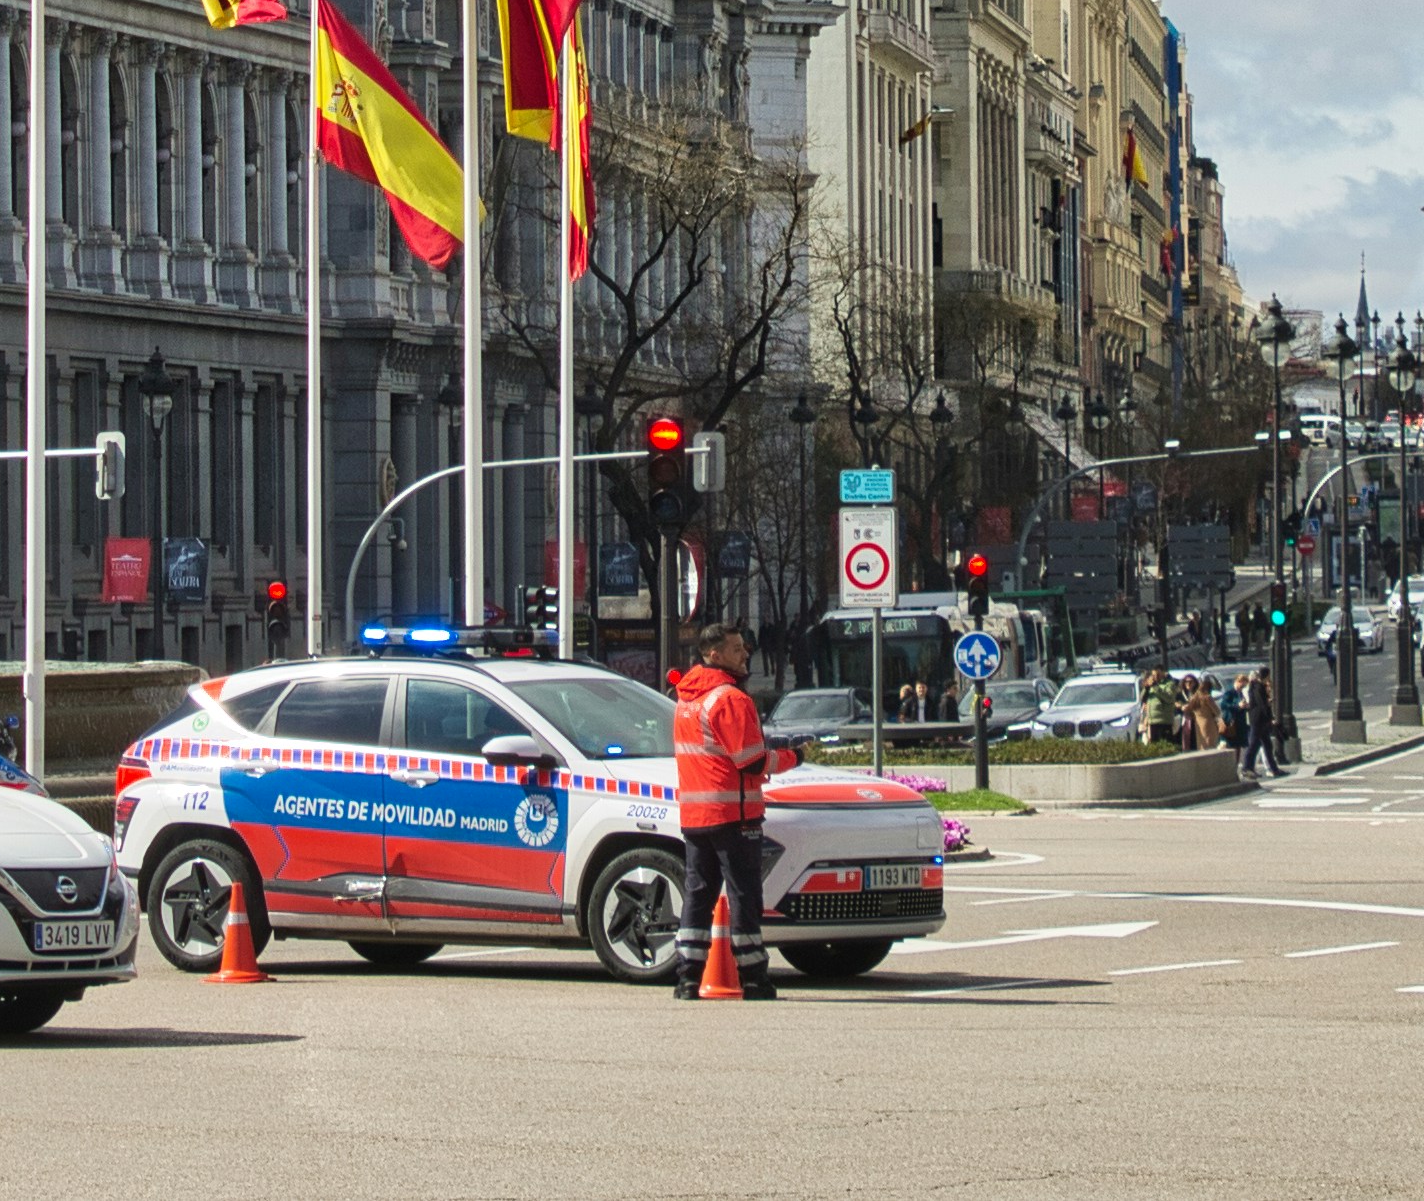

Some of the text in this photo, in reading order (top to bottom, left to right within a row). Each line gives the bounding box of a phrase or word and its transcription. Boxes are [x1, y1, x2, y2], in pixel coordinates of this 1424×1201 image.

[844, 620, 853, 635] 2
[183, 790, 210, 810] 112
[274, 794, 508, 832] AGENTES DE MOVILIDAD MADRID
[627, 804, 668, 820] 20028
[872, 868, 899, 884] 1193
[45, 924, 110, 945] 3419 LVV
